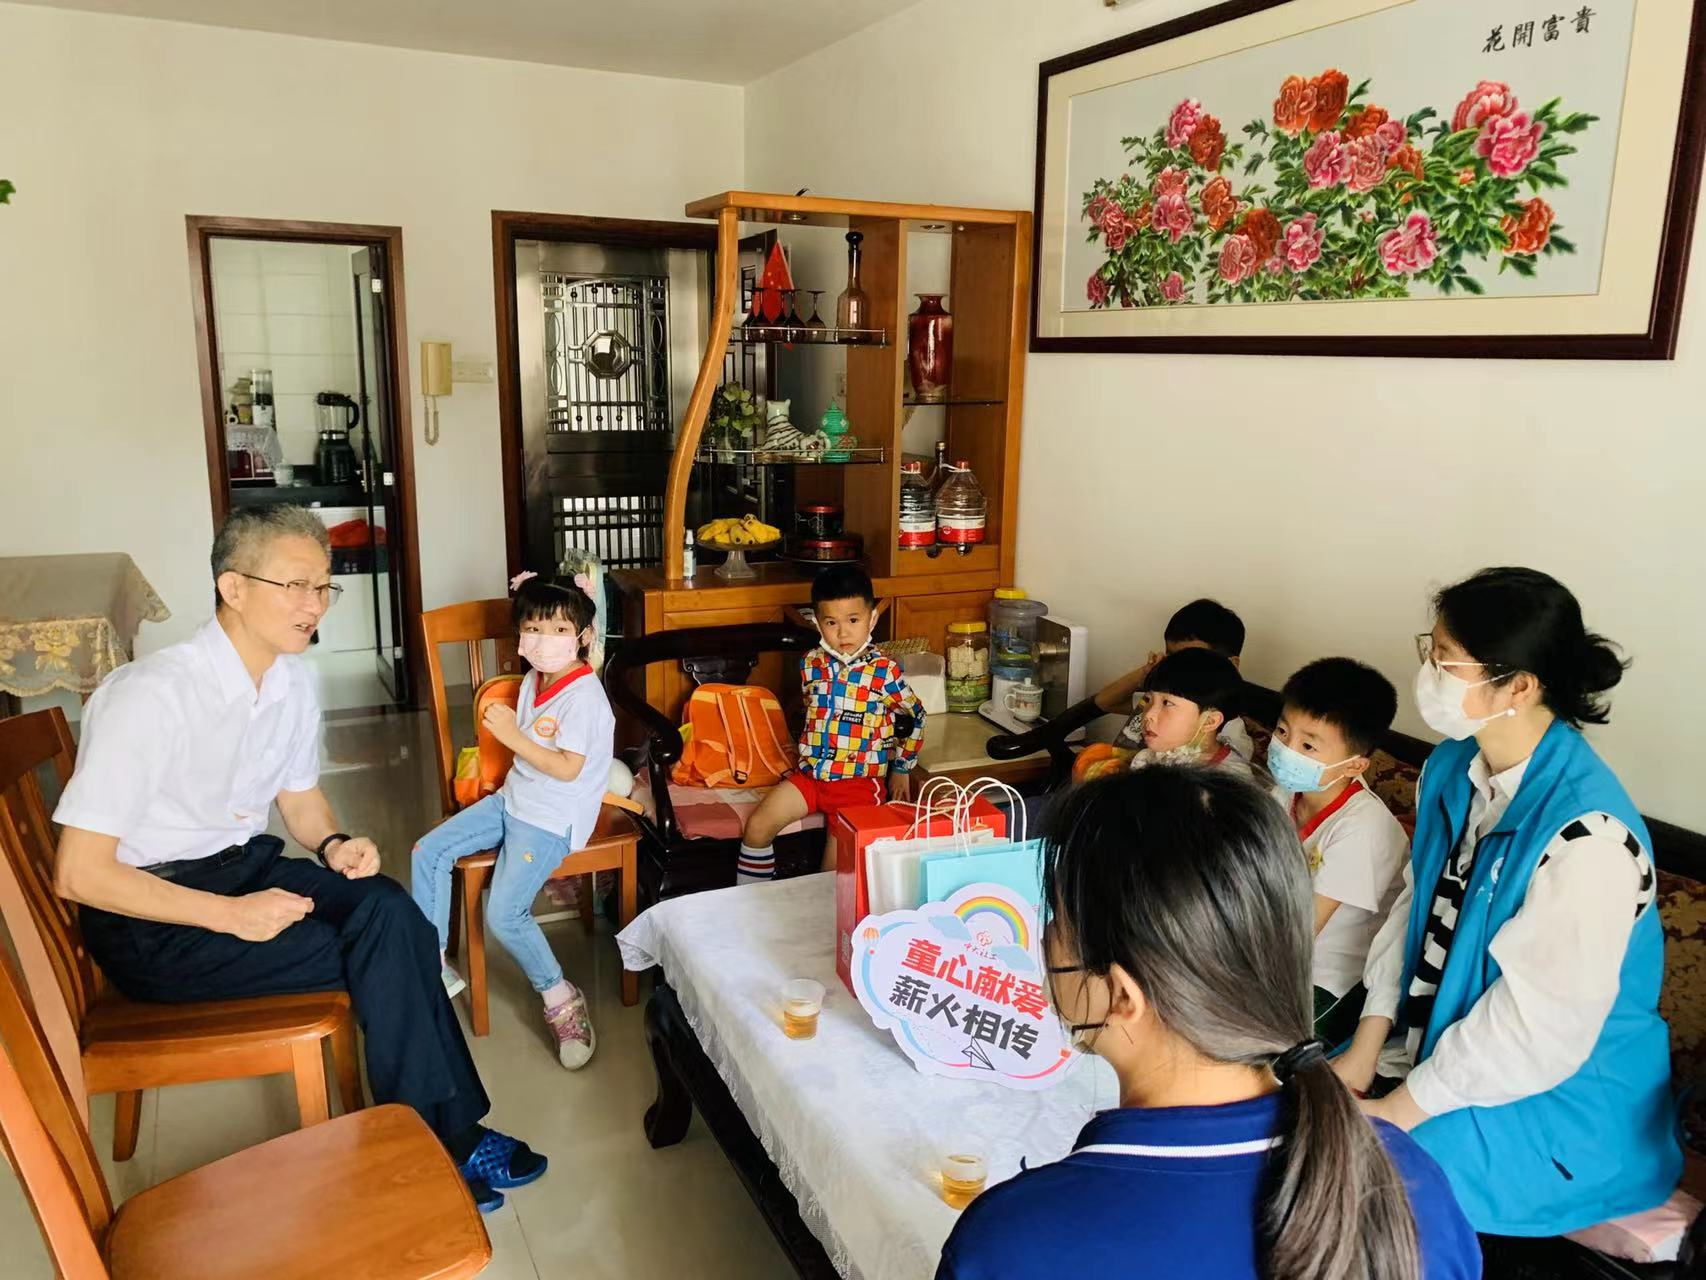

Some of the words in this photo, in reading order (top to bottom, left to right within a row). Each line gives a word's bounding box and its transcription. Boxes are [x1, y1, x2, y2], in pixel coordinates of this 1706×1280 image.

[1482, 5, 1597, 53] 花開富貴
[889, 975, 1039, 1060] 薪火相传
[902, 938, 1049, 1020] 童心献爱
